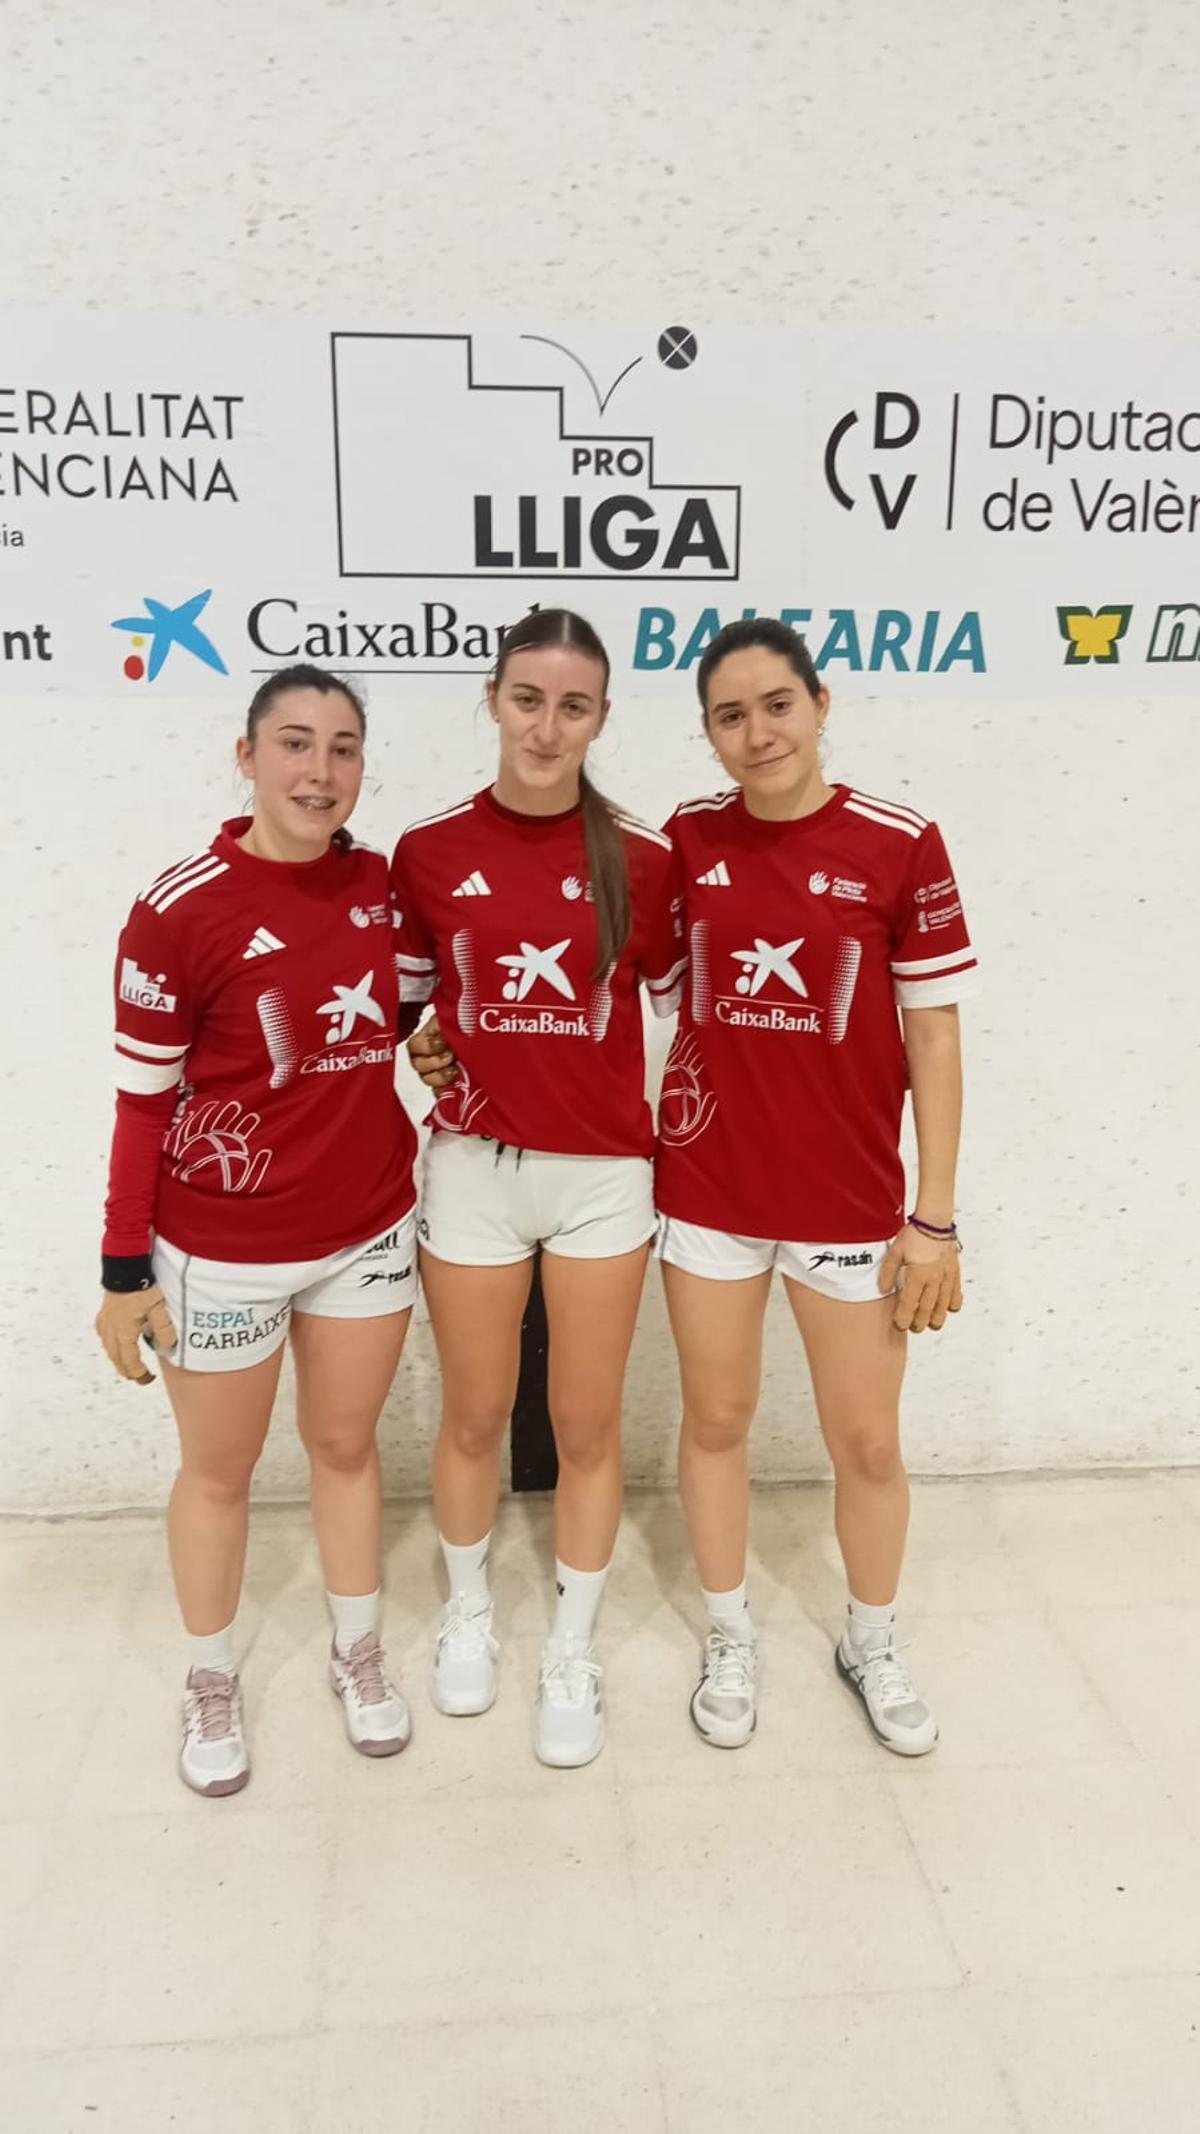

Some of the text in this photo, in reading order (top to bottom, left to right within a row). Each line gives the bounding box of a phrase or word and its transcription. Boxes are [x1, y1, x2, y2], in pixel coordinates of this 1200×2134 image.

[0, 388, 243, 440] ERALITAT
[0, 452, 239, 502] NCIANA
[572, 447, 644, 478] PRO
[982, 477, 1053, 533] de
[0, 523, 24, 547] ia
[473, 494, 730, 571] LLIGA
[3, 624, 53, 662] nt
[246, 598, 540, 660] CaixaBa
[633, 607, 986, 673] BAARIA
[122, 983, 168, 1010] LLIGA
[479, 1008, 590, 1037] CaixaBank
[715, 1000, 821, 1034] CaixaBank
[192, 1307, 255, 1329] ESPAI
